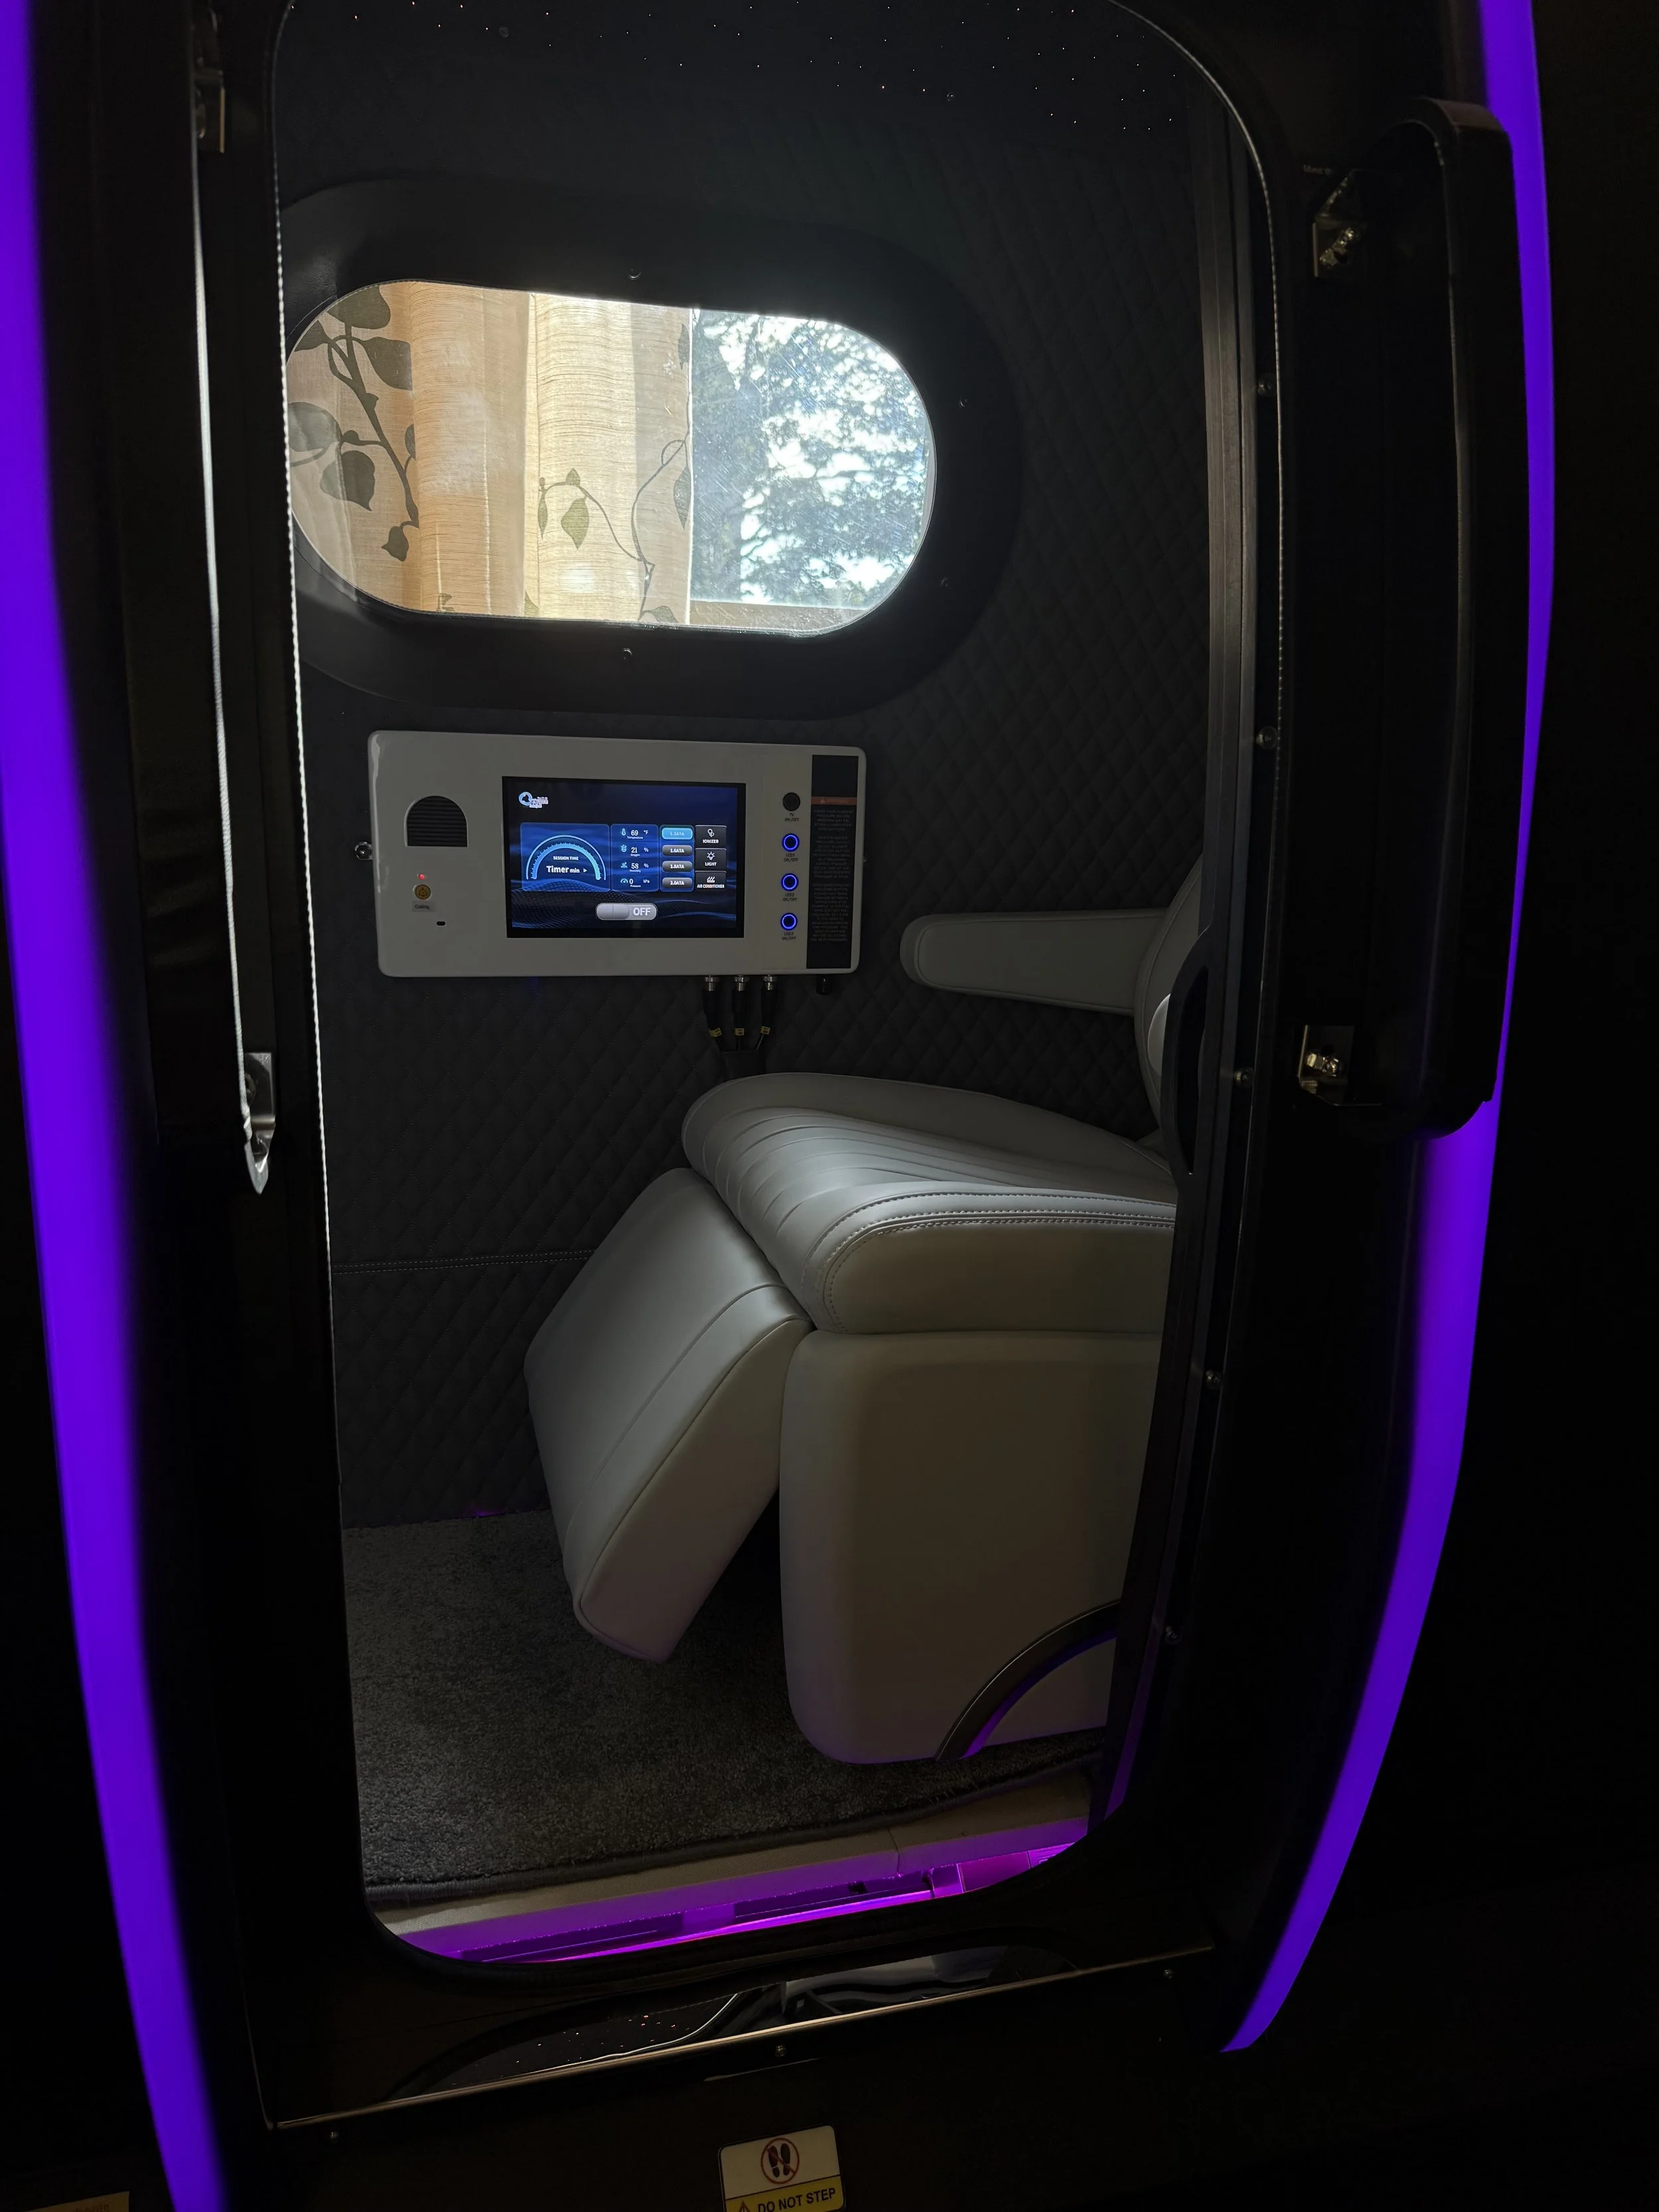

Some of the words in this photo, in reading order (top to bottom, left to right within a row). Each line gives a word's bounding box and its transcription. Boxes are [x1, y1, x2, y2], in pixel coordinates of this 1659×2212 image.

[546, 865, 569, 873] Timer
[633, 907, 651, 916] OFF
[758, 2201, 775, 2212] DO
[779, 2195, 804, 2211] NOT
[806, 2187, 836, 2204] STEP
